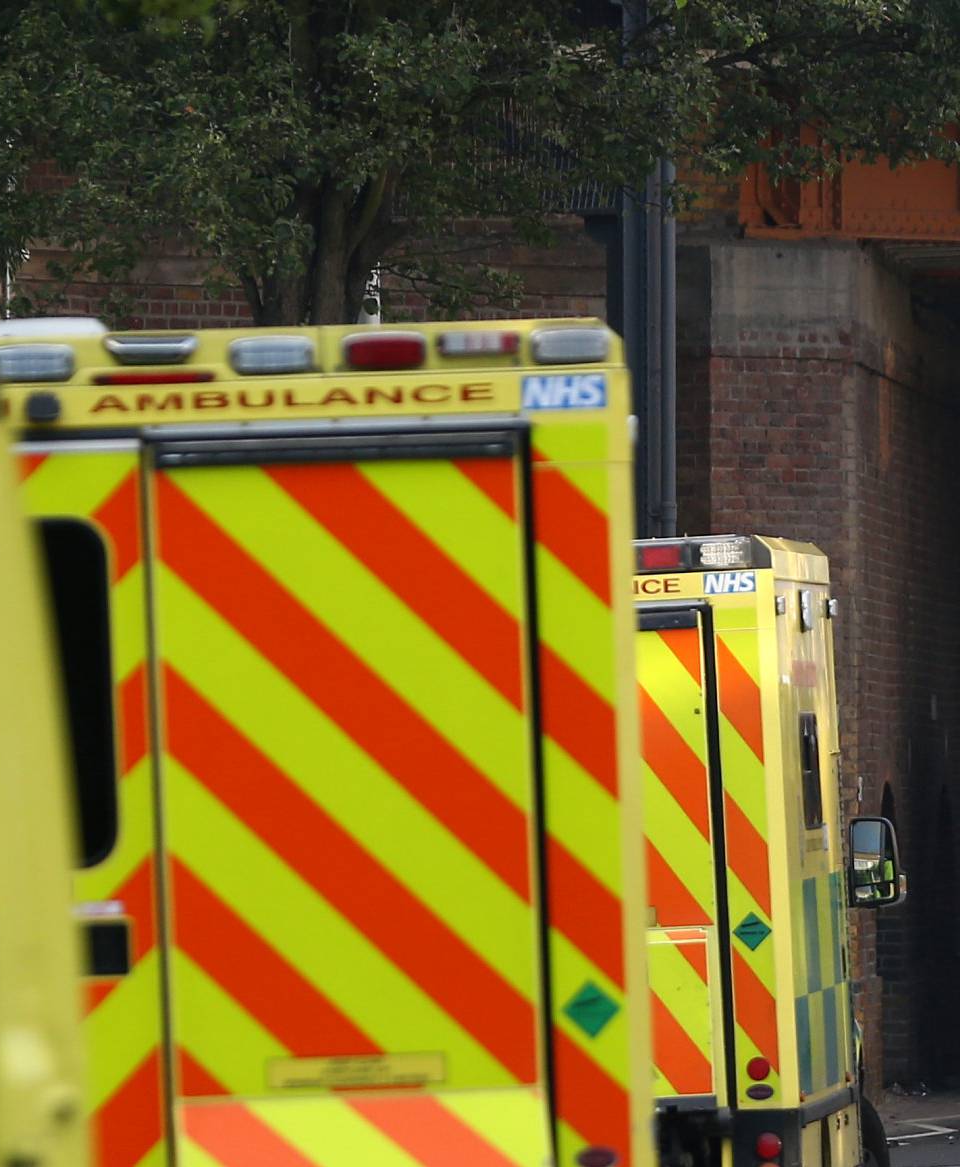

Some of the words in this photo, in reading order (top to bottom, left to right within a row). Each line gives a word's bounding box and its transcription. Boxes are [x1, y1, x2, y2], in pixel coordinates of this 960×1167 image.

[90, 382, 495, 412] AMBULANCE
[524, 374, 605, 408] NHS
[704, 571, 755, 594] NHS
